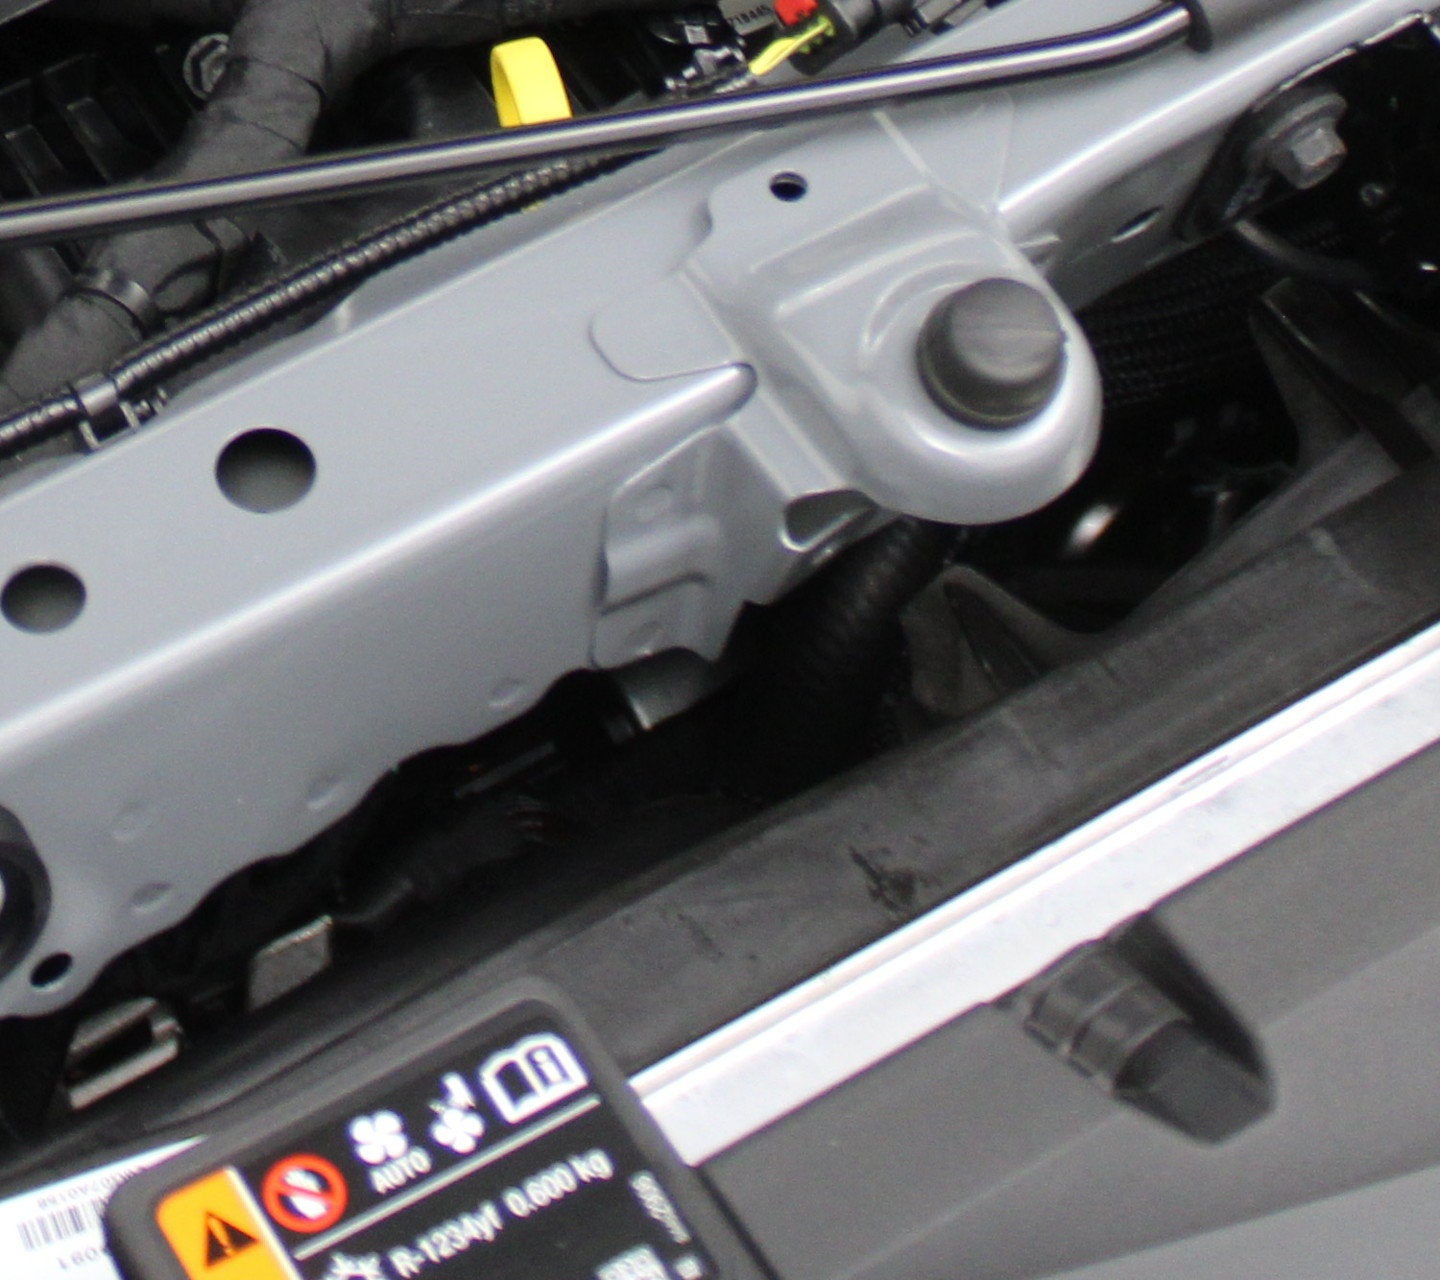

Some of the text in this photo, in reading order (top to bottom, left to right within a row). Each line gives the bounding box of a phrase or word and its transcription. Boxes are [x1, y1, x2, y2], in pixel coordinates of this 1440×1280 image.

[369, 1145, 433, 1195] AUTO
[389, 1201, 503, 1279] R-1234yf
[501, 1162, 579, 1218] 0.600
[569, 1147, 614, 1183] kg
